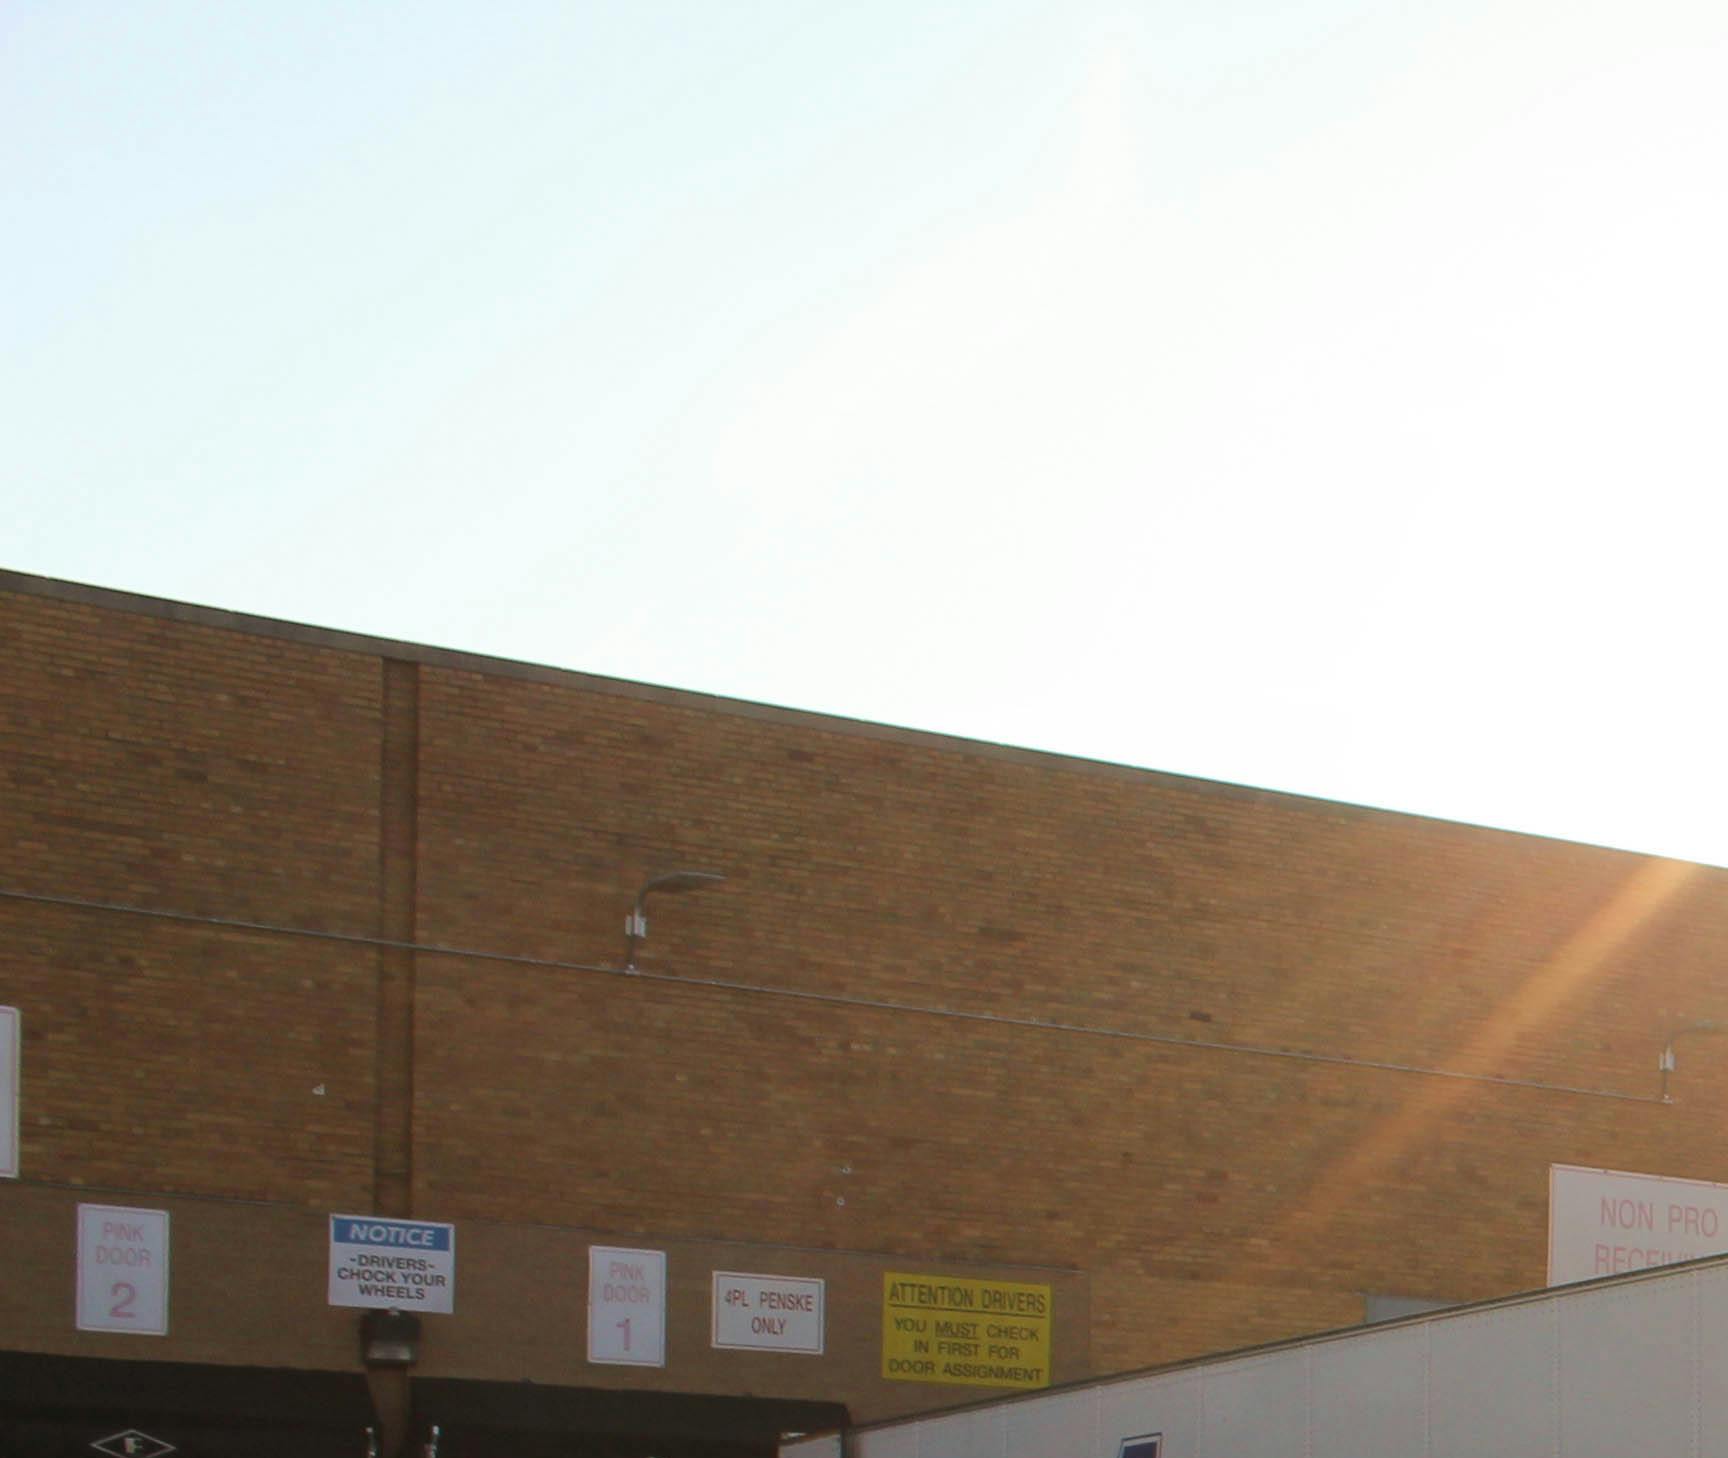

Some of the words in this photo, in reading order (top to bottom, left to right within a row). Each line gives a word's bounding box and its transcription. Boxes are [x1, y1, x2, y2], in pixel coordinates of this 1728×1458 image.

[1600, 1197, 1654, 1230] NON
[1667, 1204, 1719, 1237] PRO
[103, 1221, 145, 1242] PINK
[350, 1223, 435, 1246] NOTICE
[96, 1245, 151, 1268] DOOR
[337, 1267, 397, 1284] CHOCK
[401, 1272, 446, 1287] YOUR
[610, 1261, 645, 1281] PINK
[109, 1281, 137, 1319] 2
[358, 1284, 425, 1300] WHEELS
[604, 1284, 650, 1304] DOOR
[724, 1289, 748, 1308] 4PL
[759, 1291, 814, 1313] PENSKE
[889, 1281, 974, 1308] ATTENTION
[982, 1288, 1046, 1315] DRIVERS
[616, 1317, 632, 1351] 1
[751, 1316, 788, 1336] ONLY
[894, 1317, 928, 1333] YOU
[935, 1321, 980, 1339] MUST
[986, 1324, 1040, 1342] CHECK
[914, 1340, 929, 1354] IN
[937, 1341, 980, 1358] FIRST
[988, 1345, 1020, 1361] FOR
[888, 1359, 936, 1376] DOOR
[942, 1363, 1042, 1382] ASSIGNMENT
